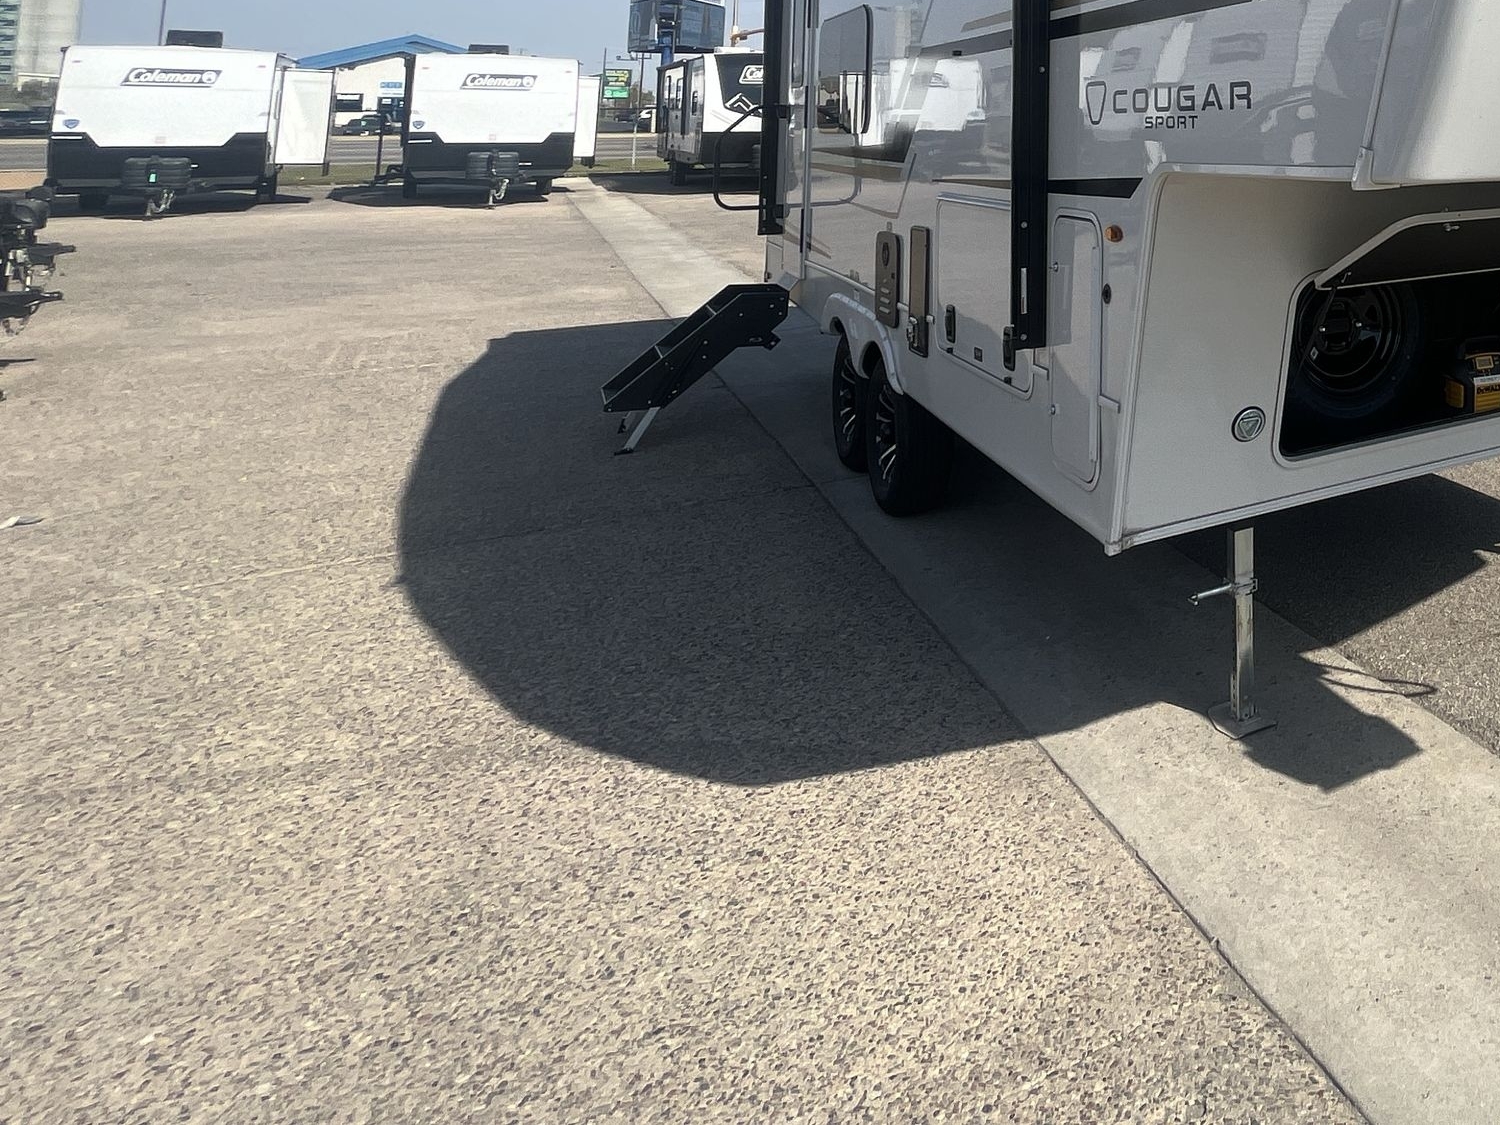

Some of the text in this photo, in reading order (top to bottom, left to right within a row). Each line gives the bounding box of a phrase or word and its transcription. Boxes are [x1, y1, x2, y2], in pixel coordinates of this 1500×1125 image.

[128, 68, 202, 83] Coleman
[465, 74, 522, 87] Coleman
[1112, 80, 1252, 114] COUGAR
[1144, 115, 1199, 129] SPORT
